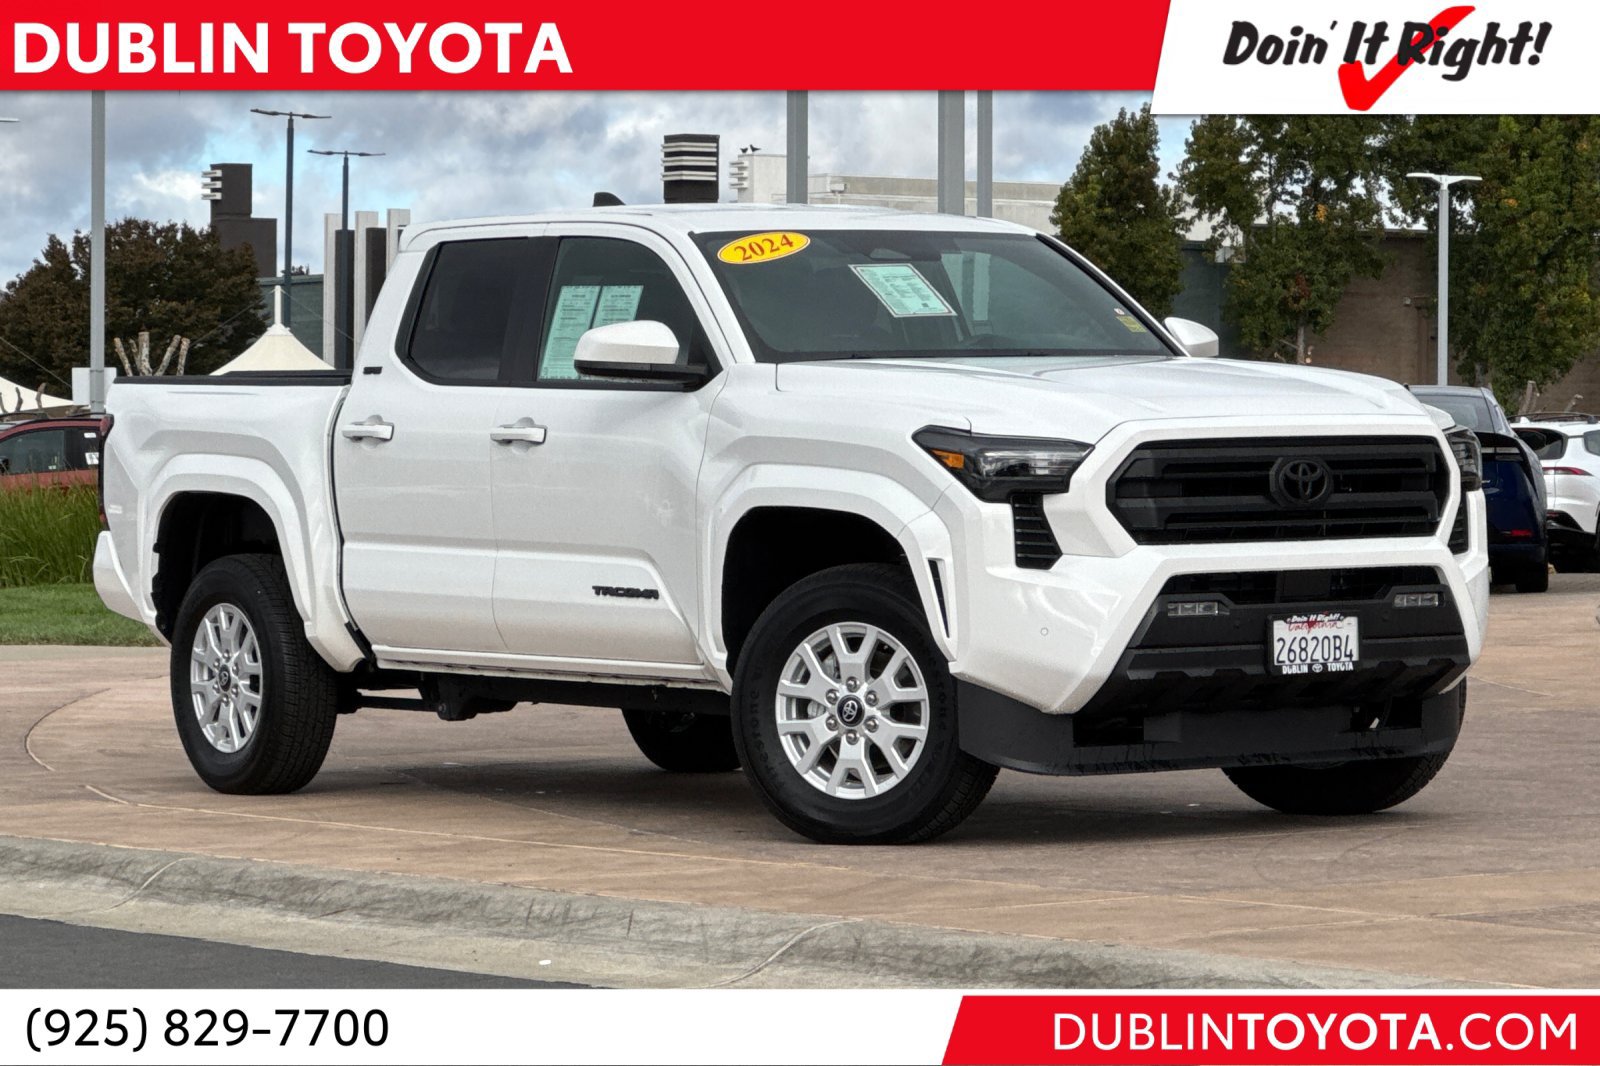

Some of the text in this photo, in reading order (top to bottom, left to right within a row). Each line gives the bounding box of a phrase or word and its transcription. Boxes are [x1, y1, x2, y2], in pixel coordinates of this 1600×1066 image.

[734, 234, 794, 261] 2024
[1276, 634, 1354, 664] 26820B4
[1282, 662, 1354, 675] DUBLIN TOYOTA
